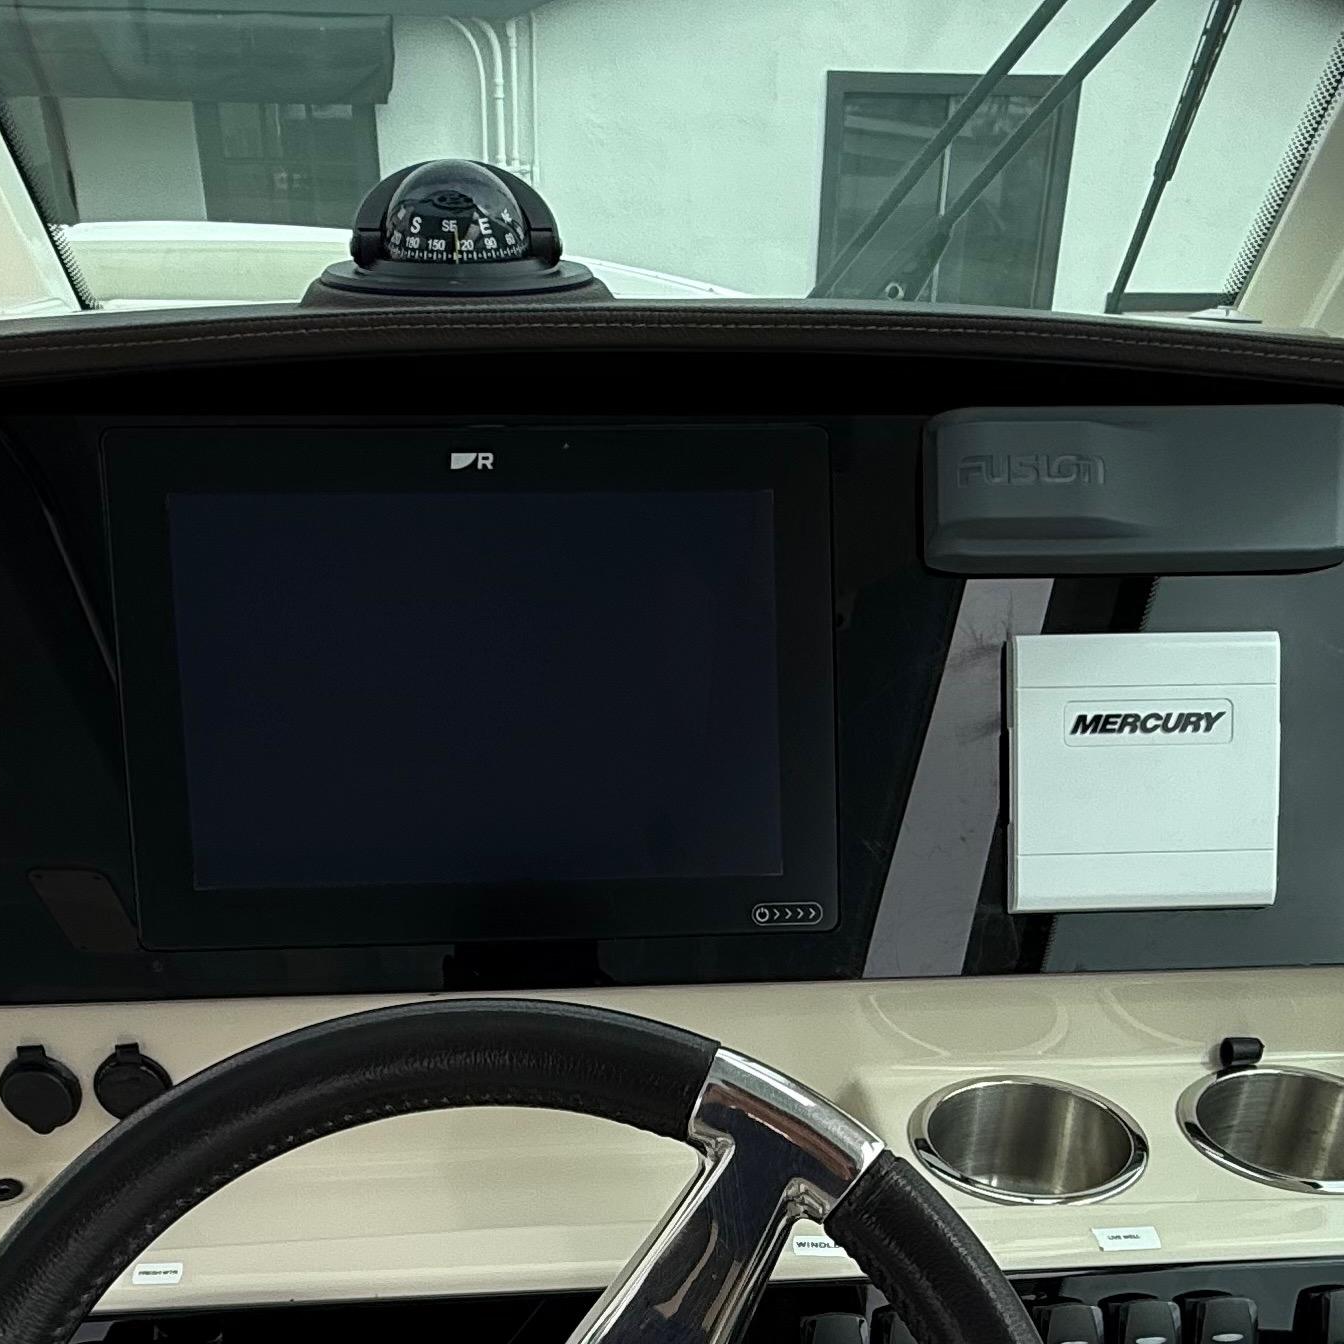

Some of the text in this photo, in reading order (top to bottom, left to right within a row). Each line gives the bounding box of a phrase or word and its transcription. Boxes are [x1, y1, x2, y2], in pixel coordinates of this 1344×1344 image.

[410, 217, 492, 235] S SE E
[428, 239, 445, 251] 150
[484, 237, 497, 249] 90
[1070, 711, 1226, 735] MERCURY
